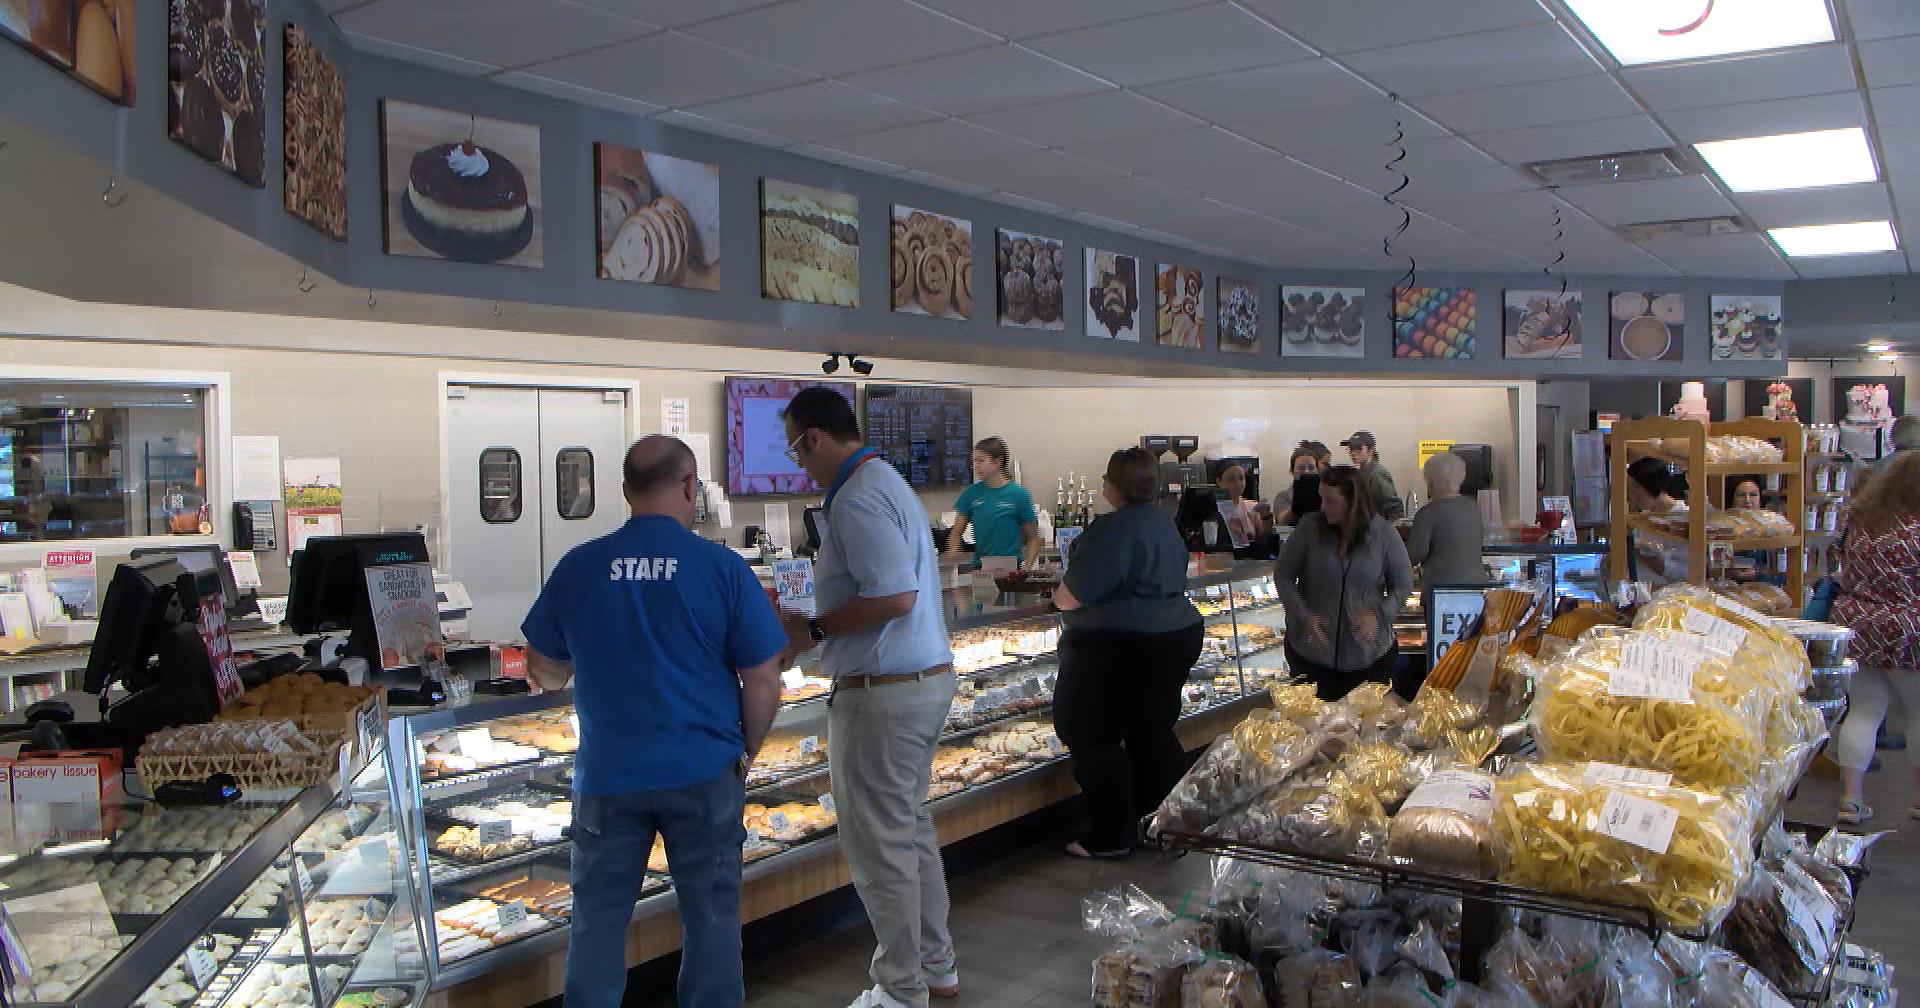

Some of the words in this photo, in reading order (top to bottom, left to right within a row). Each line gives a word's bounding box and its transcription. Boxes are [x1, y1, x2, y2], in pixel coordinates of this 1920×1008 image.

[49, 554, 91, 564] ATTENTION
[610, 557, 678, 581] STAFF
[12, 765, 57, 781] bakery
[63, 764, 98, 777] tissue
